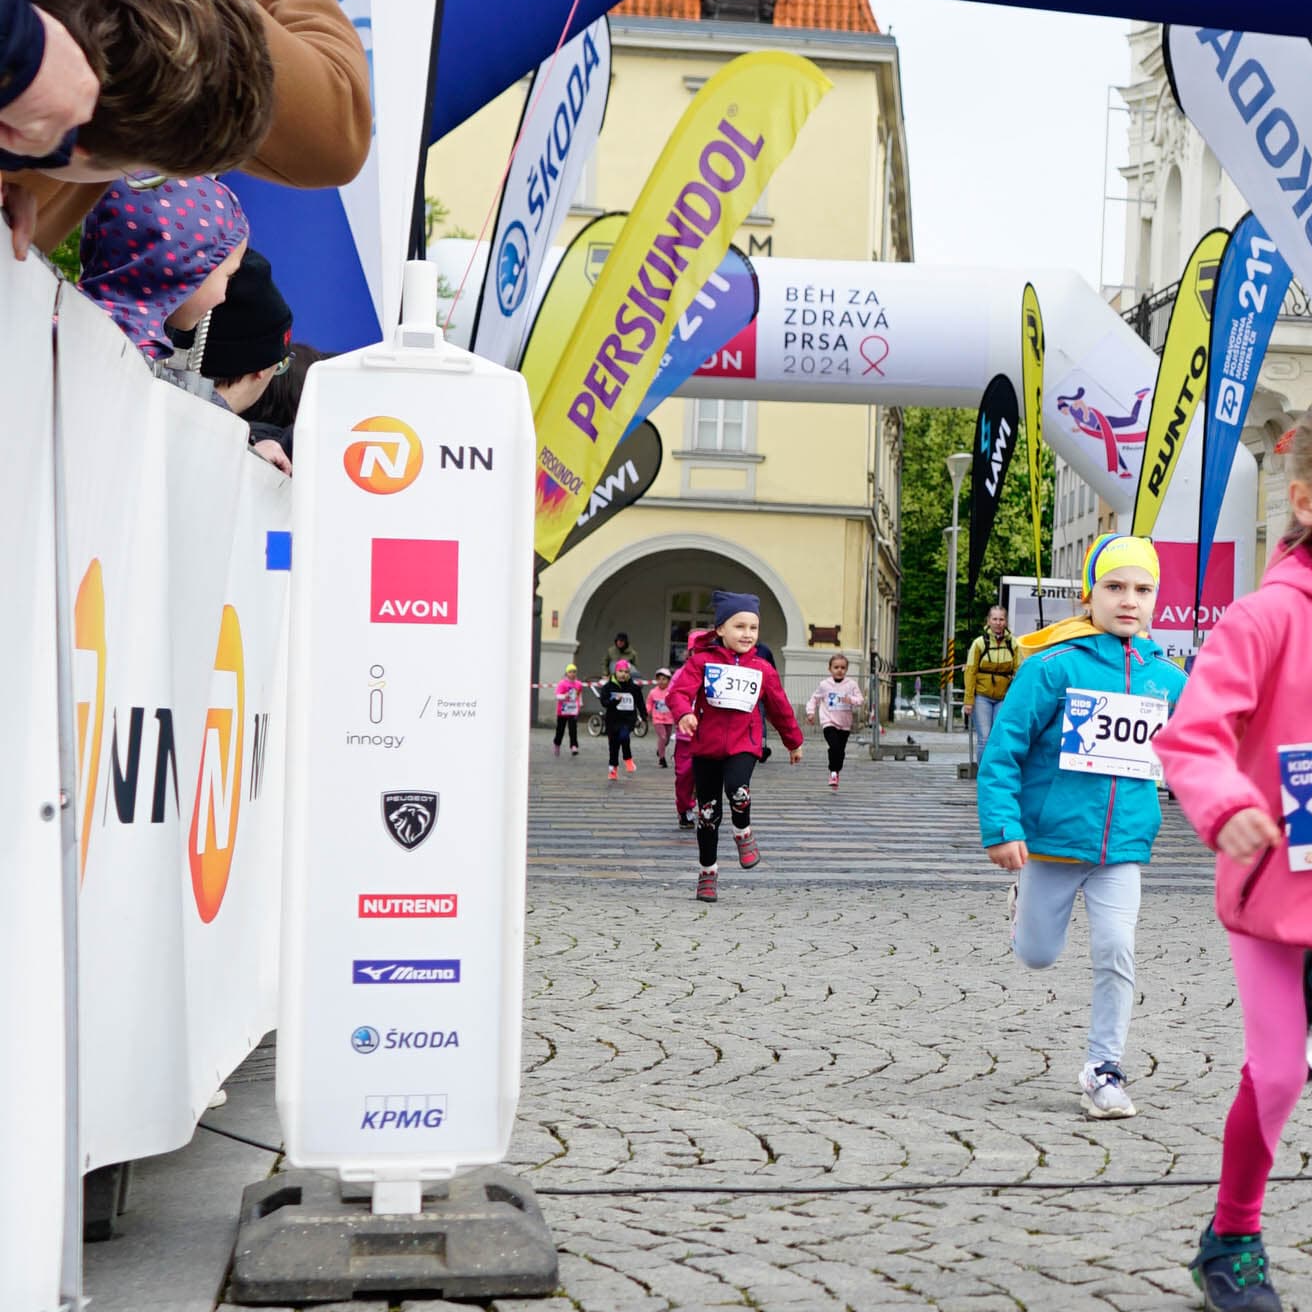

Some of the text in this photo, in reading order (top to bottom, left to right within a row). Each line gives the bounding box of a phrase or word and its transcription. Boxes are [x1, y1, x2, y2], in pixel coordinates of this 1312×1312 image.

[527, 30, 601, 234] ŠKODA
[566, 116, 765, 444] PERSKINDOL
[1238, 236, 1277, 313] 211
[785, 284, 879, 305] BĚH ZA
[784, 306, 889, 329] ZDRAVÁ
[784, 331, 848, 352] PRSA
[784, 354, 851, 375] 2024
[1148, 344, 1207, 497] RUNTO
[440, 445, 493, 471] NN
[985, 416, 1012, 498] LAWI
[378, 599, 449, 617] AVON
[725, 677, 758, 695] 3179
[437, 699, 477, 709] Powered
[437, 710, 476, 720] by MVM
[346, 731, 404, 750] innogy
[386, 795, 434, 803] PEUGEOT
[363, 898, 454, 914] NUTREND
[384, 1029, 460, 1049] ŠKODA
[361, 1108, 444, 1129] KPMG
